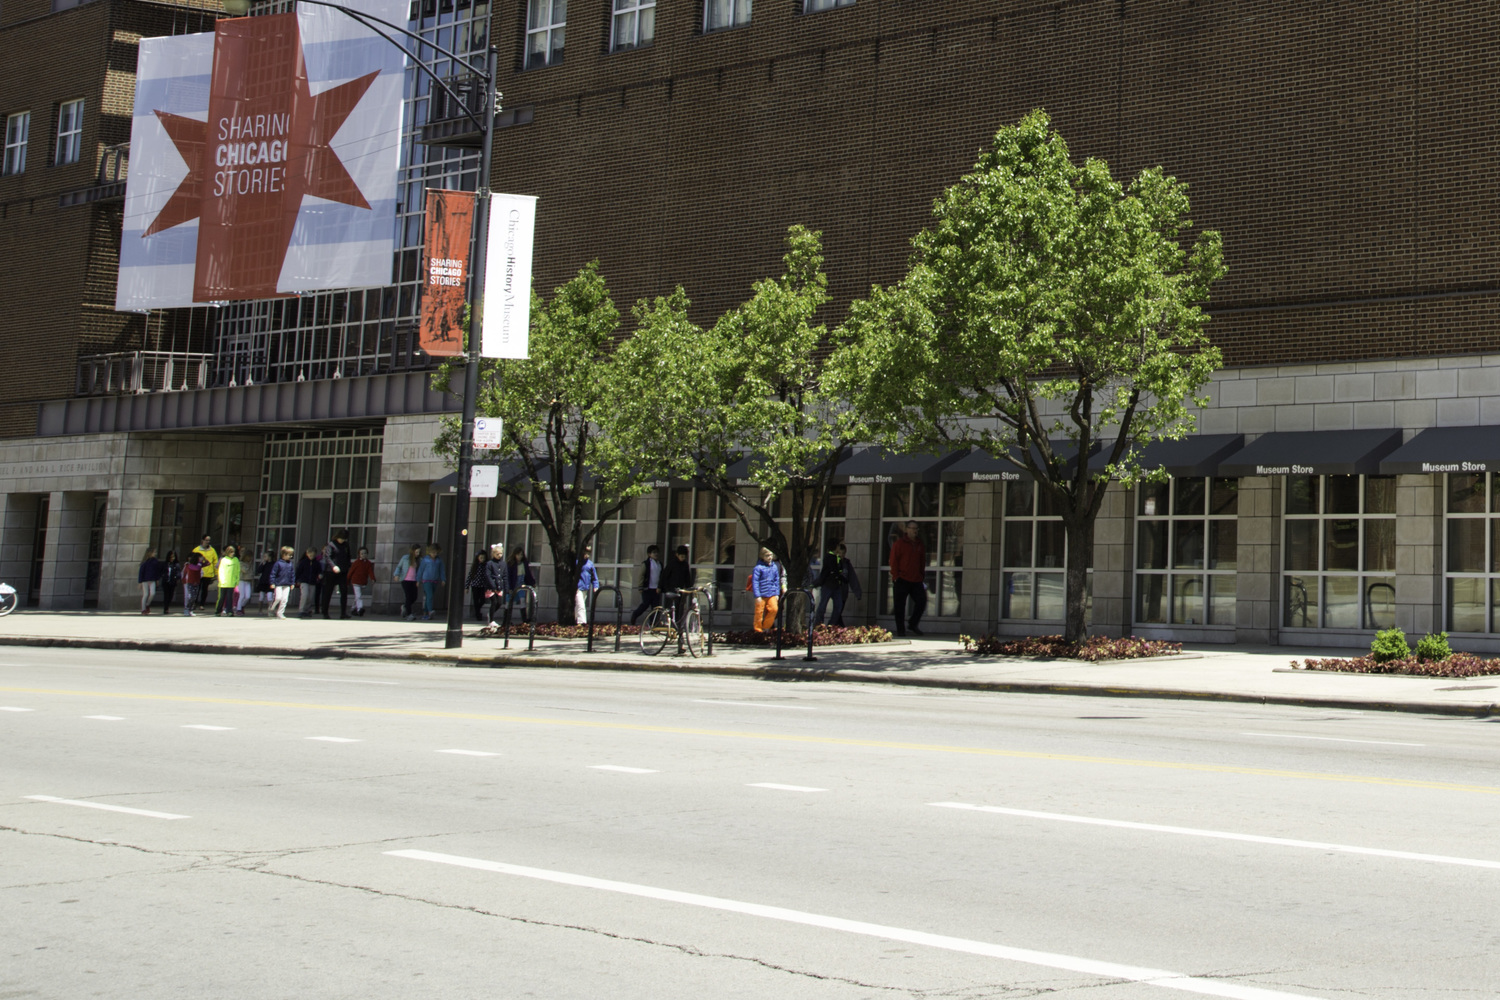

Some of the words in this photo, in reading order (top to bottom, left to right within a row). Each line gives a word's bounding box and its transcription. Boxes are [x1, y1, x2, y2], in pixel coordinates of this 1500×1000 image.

[430, 258, 463, 268] SHARING
[430, 267, 462, 276] CHICAGO
[430, 276, 461, 286] STORIES
[403, 447, 442, 459] CHICA
[1256, 465, 1290, 474] Museum
[1292, 464, 1313, 474] Store
[1422, 462, 1459, 472] Museum
[1462, 461, 1486, 471] Store
[849, 475, 874, 483] Museum
[876, 475, 892, 483] Store
[972, 472, 1000, 480] Museum
[1001, 472, 1020, 480] Store
